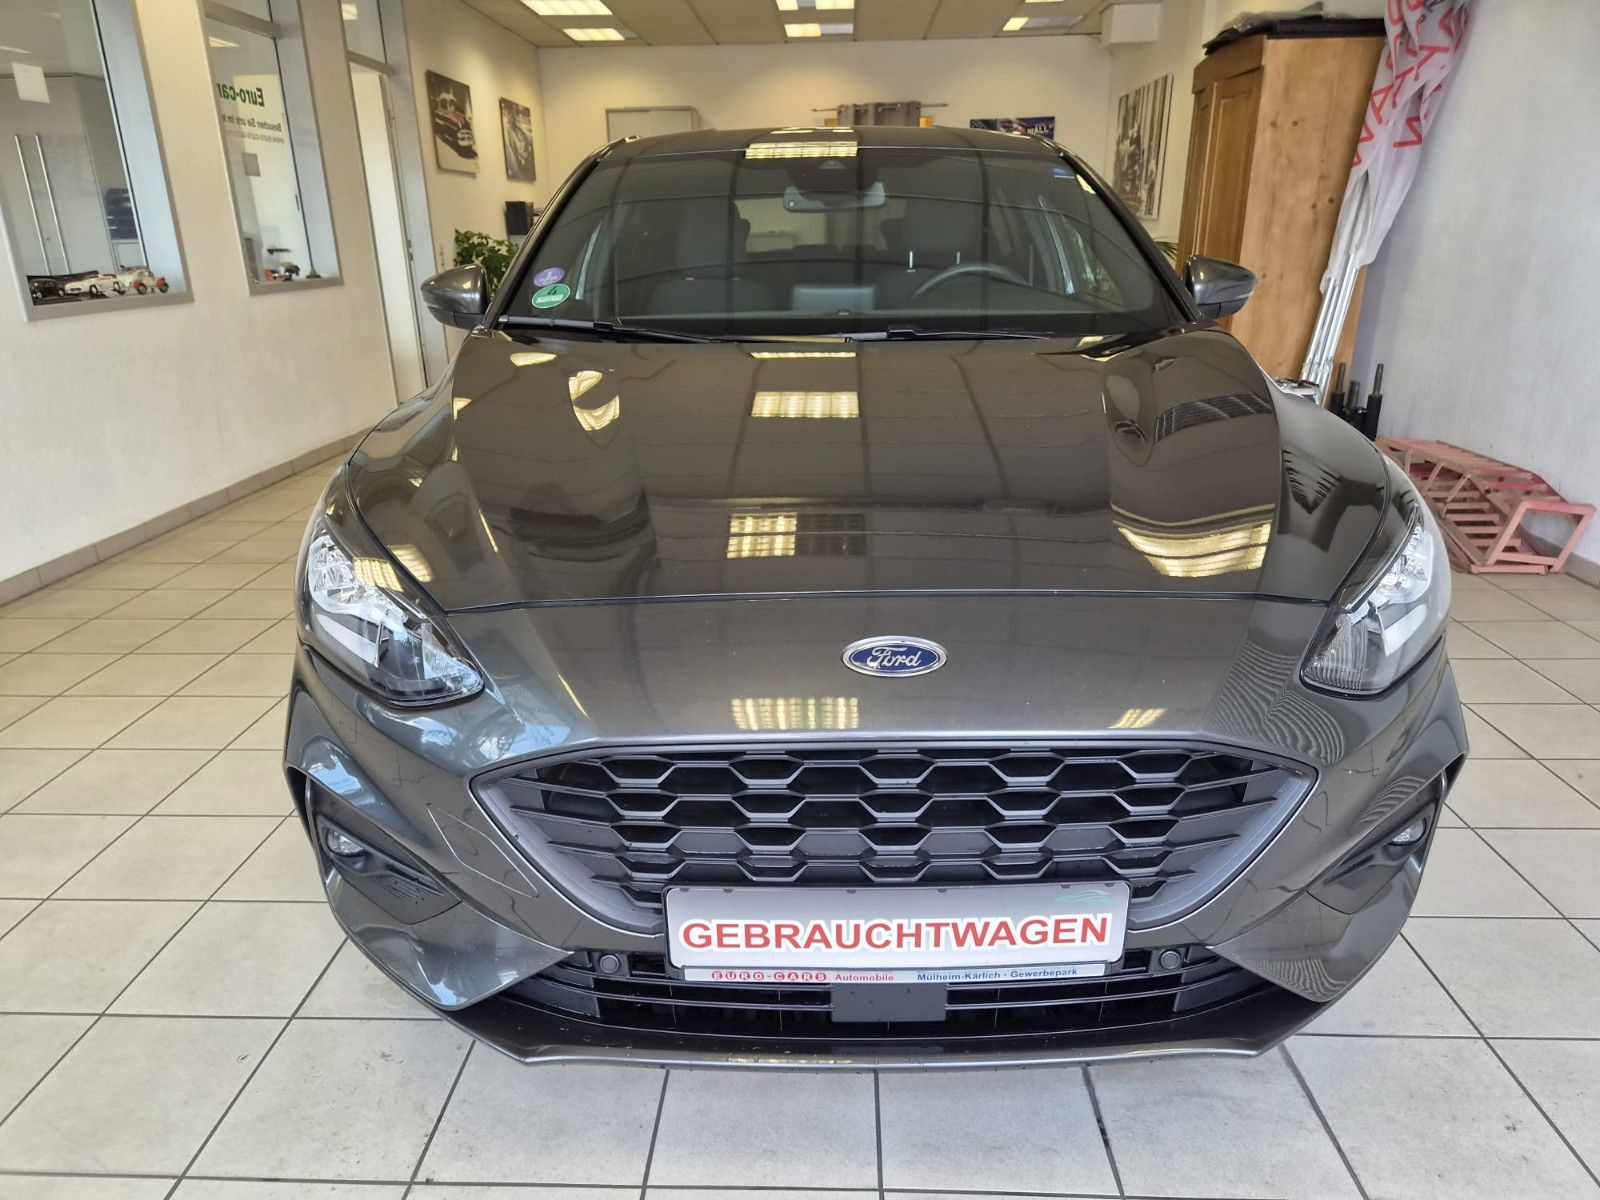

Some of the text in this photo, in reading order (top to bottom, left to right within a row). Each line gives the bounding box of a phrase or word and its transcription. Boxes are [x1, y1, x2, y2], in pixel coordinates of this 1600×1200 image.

[547, 285, 557, 295] 4
[866, 646, 922, 670] Ford
[681, 915, 1109, 951] GEBRAUCHTWAGEN
[711, 968, 1078, 983] EURO-CARS Automobile Mülheim-Kärlich Gewerbepark
